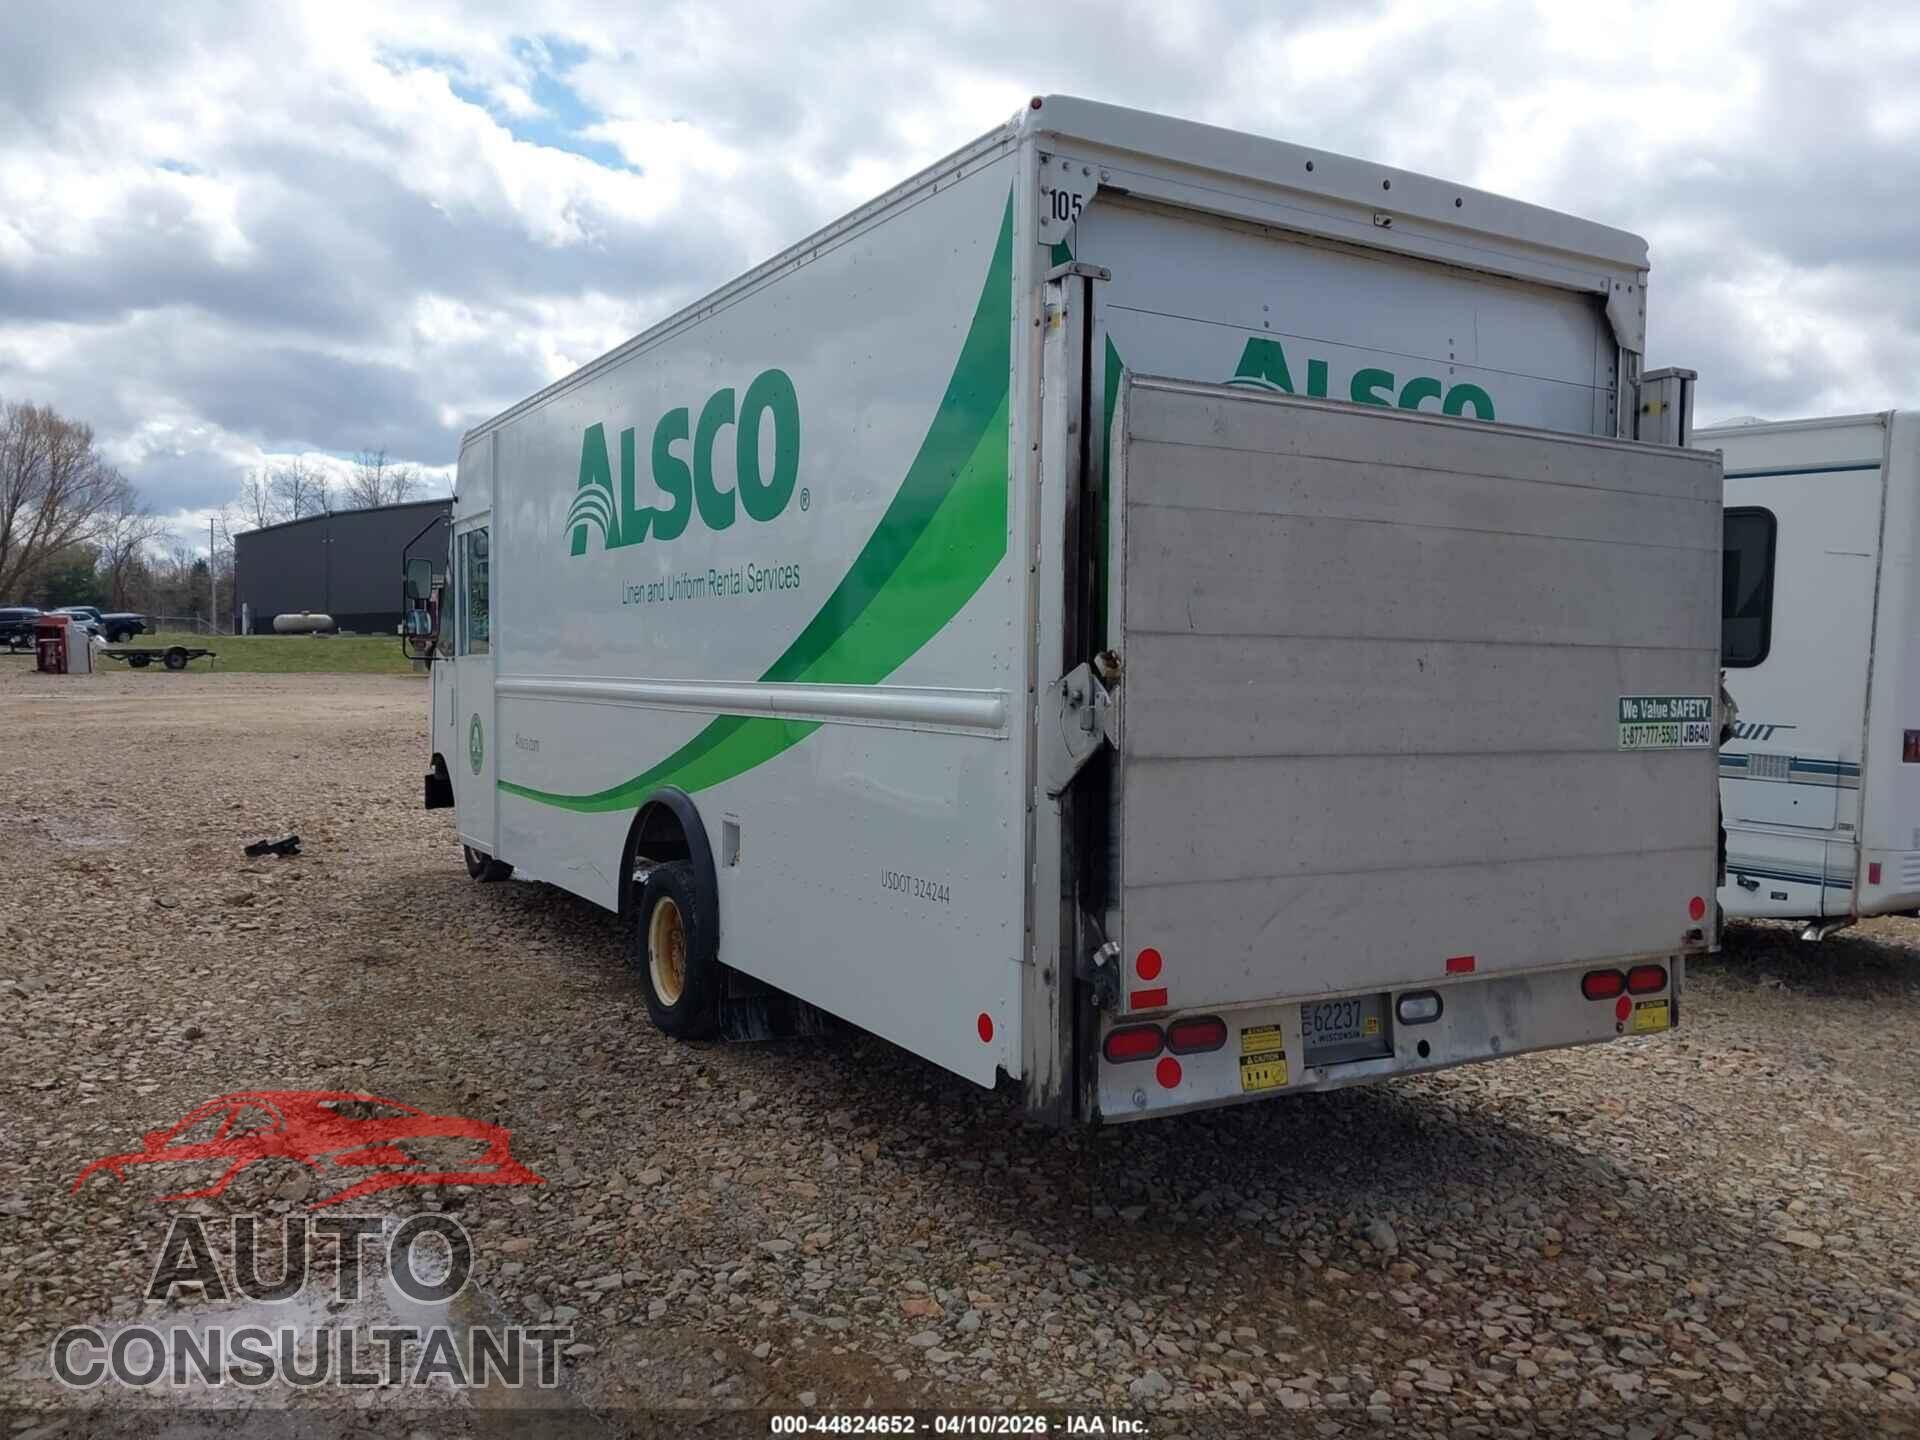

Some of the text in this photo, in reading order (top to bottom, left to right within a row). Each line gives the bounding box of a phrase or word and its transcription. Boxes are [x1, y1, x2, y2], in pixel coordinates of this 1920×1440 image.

[1049, 188, 1082, 224] 105
[564, 368, 801, 556] ALSCO
[622, 560, 801, 605] Linen and Uniform Rental Services
[1622, 699, 1709, 719] We Value SAFETY
[1683, 724, 1711, 744] JB640
[881, 867, 950, 905] USDOT 324244
[1313, 1001, 1361, 1032] 62237
